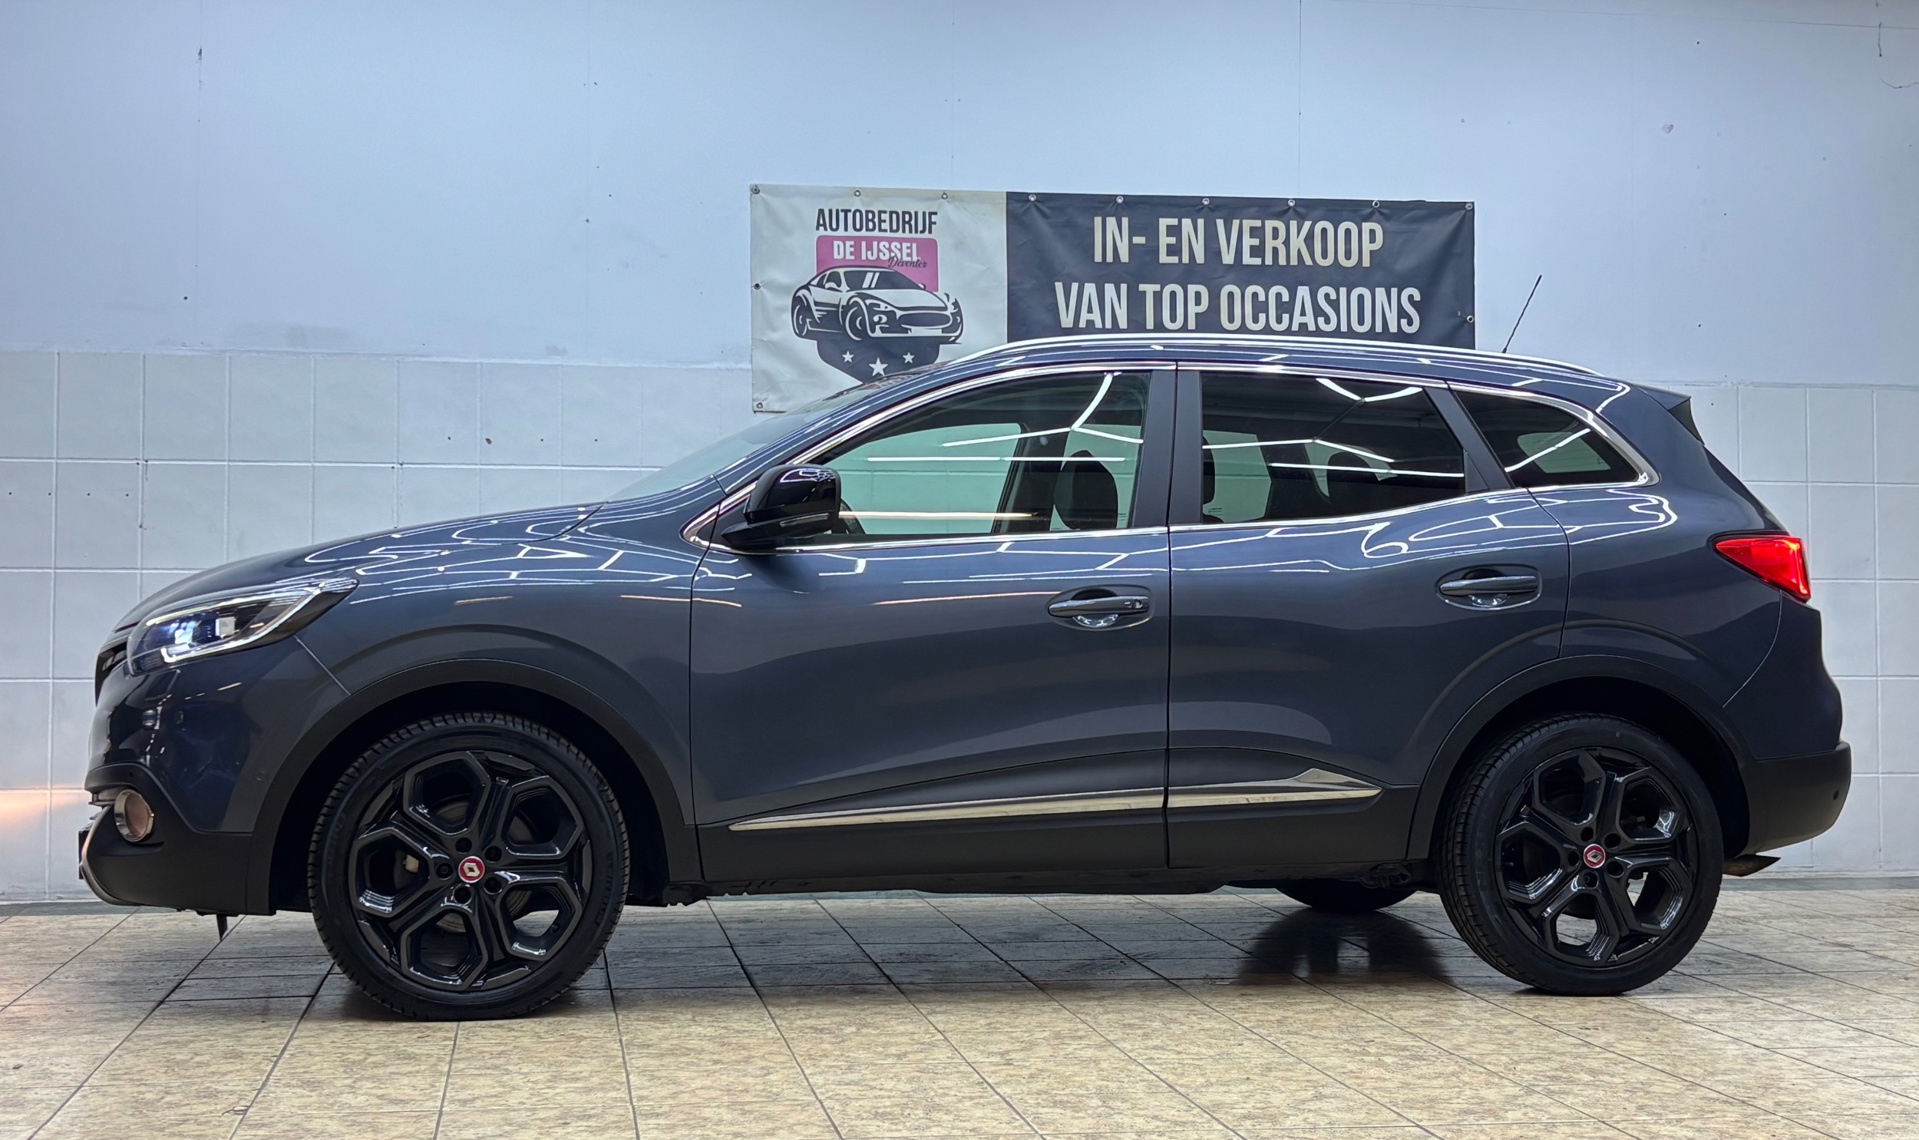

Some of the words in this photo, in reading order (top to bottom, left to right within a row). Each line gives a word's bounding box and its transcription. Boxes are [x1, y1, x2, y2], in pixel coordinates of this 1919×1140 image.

[815, 208, 938, 234] AUTOBEDRIJF
[833, 240, 855, 260] DE
[861, 240, 920, 262] IJSSEL
[1093, 216, 1147, 263] IN-
[1158, 217, 1205, 264] EN
[1215, 219, 1384, 267] VERKOOP
[1054, 281, 1128, 330] VAN
[1138, 283, 1209, 331] TOP
[1219, 284, 1421, 333] OCCASIONS
